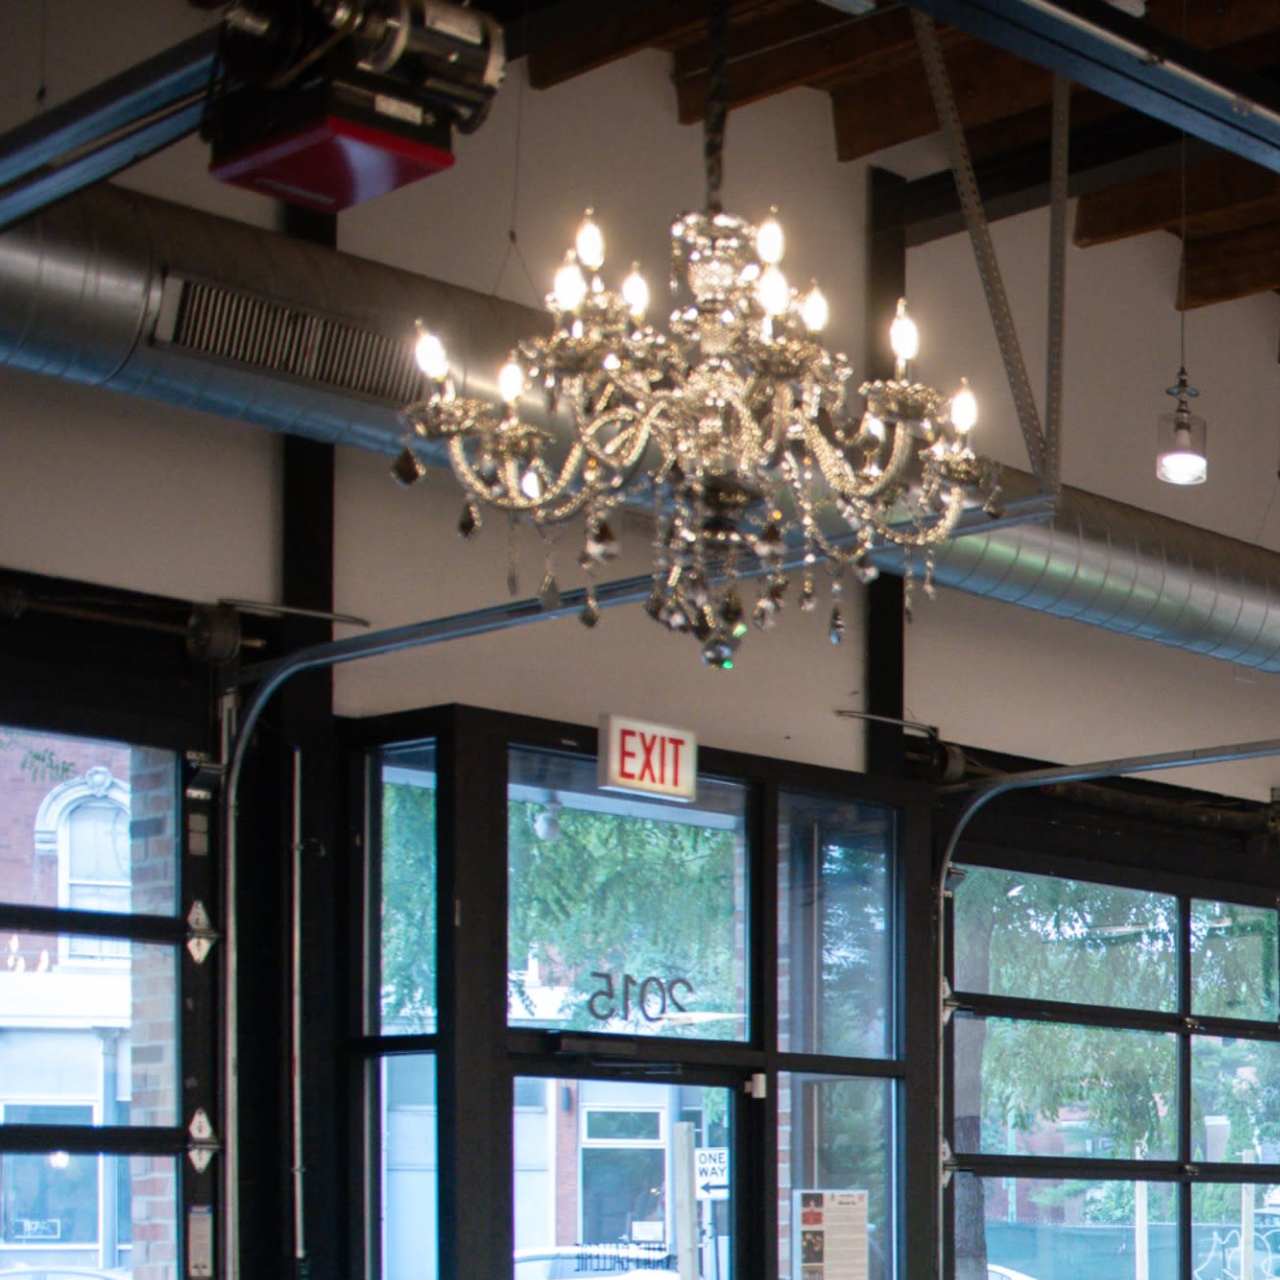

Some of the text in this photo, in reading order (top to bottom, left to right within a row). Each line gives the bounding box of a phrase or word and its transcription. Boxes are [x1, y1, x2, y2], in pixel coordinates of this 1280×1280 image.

[620, 728, 685, 787] EXIT
[699, 1153, 726, 1165] ONE
[699, 1166, 728, 1177] WAY
